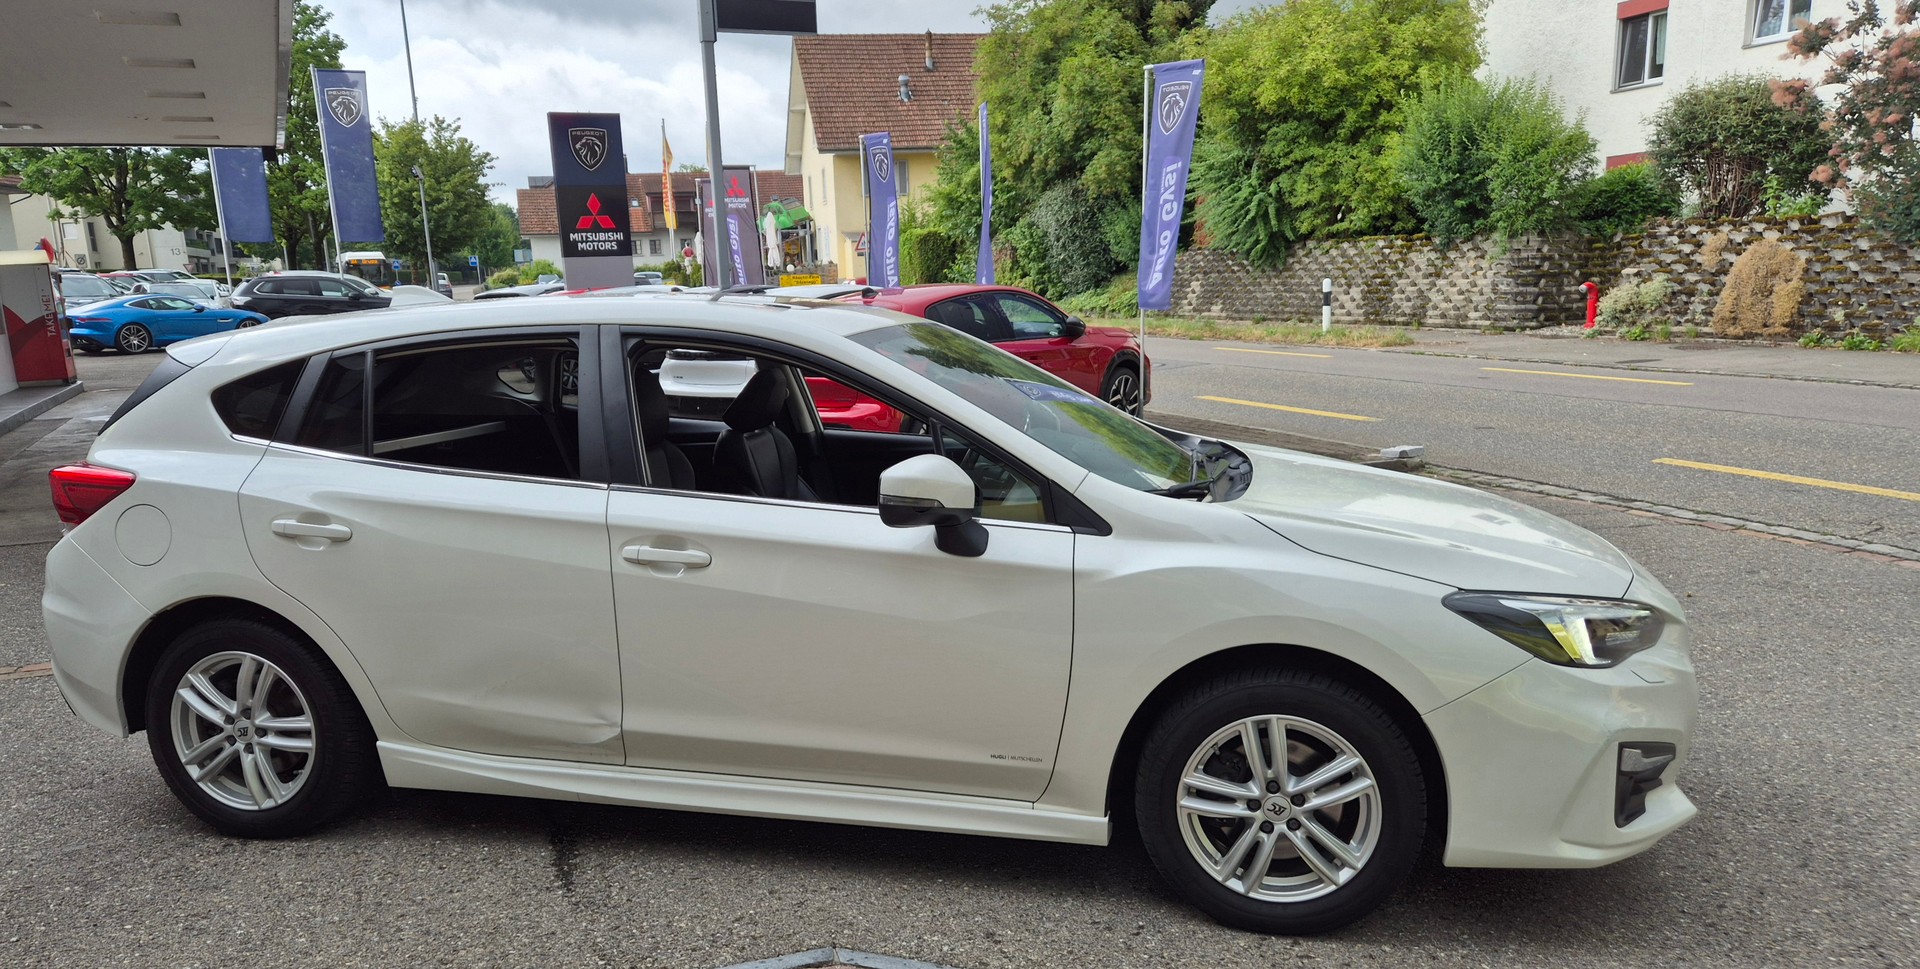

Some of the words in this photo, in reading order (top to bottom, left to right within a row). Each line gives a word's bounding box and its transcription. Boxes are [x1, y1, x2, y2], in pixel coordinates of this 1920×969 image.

[570, 232, 623, 242] MITSUBISHI
[727, 217, 738, 250] Gysi
[578, 242, 618, 251] MOTORS
[45, 313, 56, 337] TAKE
